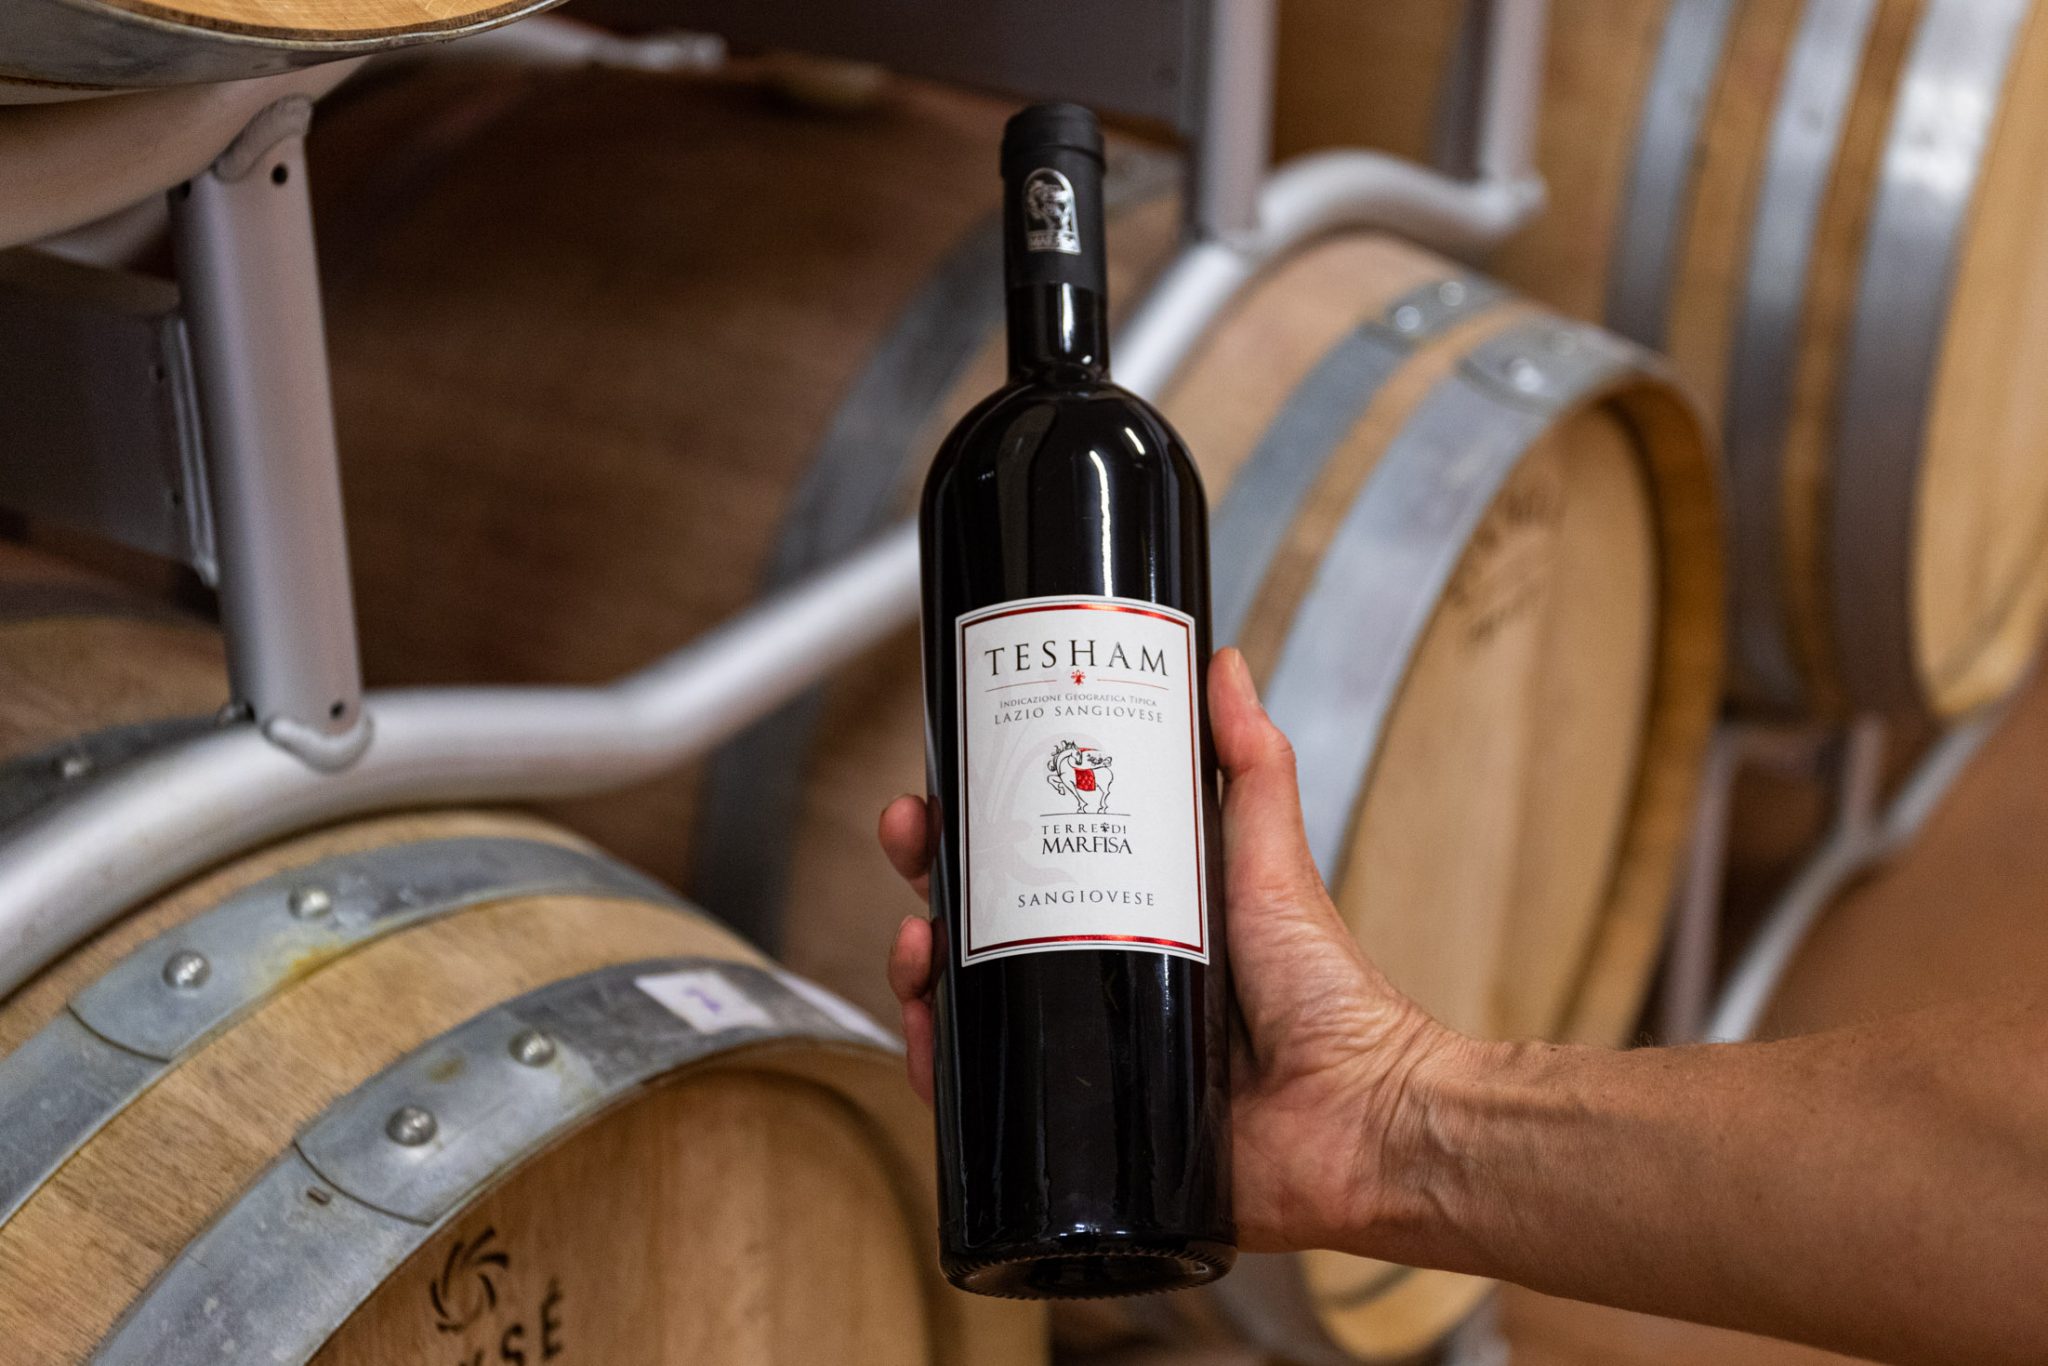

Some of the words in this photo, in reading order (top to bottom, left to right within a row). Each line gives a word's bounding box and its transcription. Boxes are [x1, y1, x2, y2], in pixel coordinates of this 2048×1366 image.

[984, 639, 1168, 677] TESHAM
[1000, 694, 1061, 708] INDICAZIONE
[1065, 693, 1126, 703] GEOGRAFICA
[1129, 696, 1158, 707] TIPICA
[994, 708, 1044, 725] LAZIO
[1055, 706, 1163, 723] SANGIOVESE
[1041, 823, 1098, 835] TERRE
[1111, 824, 1127, 835] DI
[1042, 836, 1133, 854] MARFISA
[1018, 890, 1155, 908] SANGIOVESE
